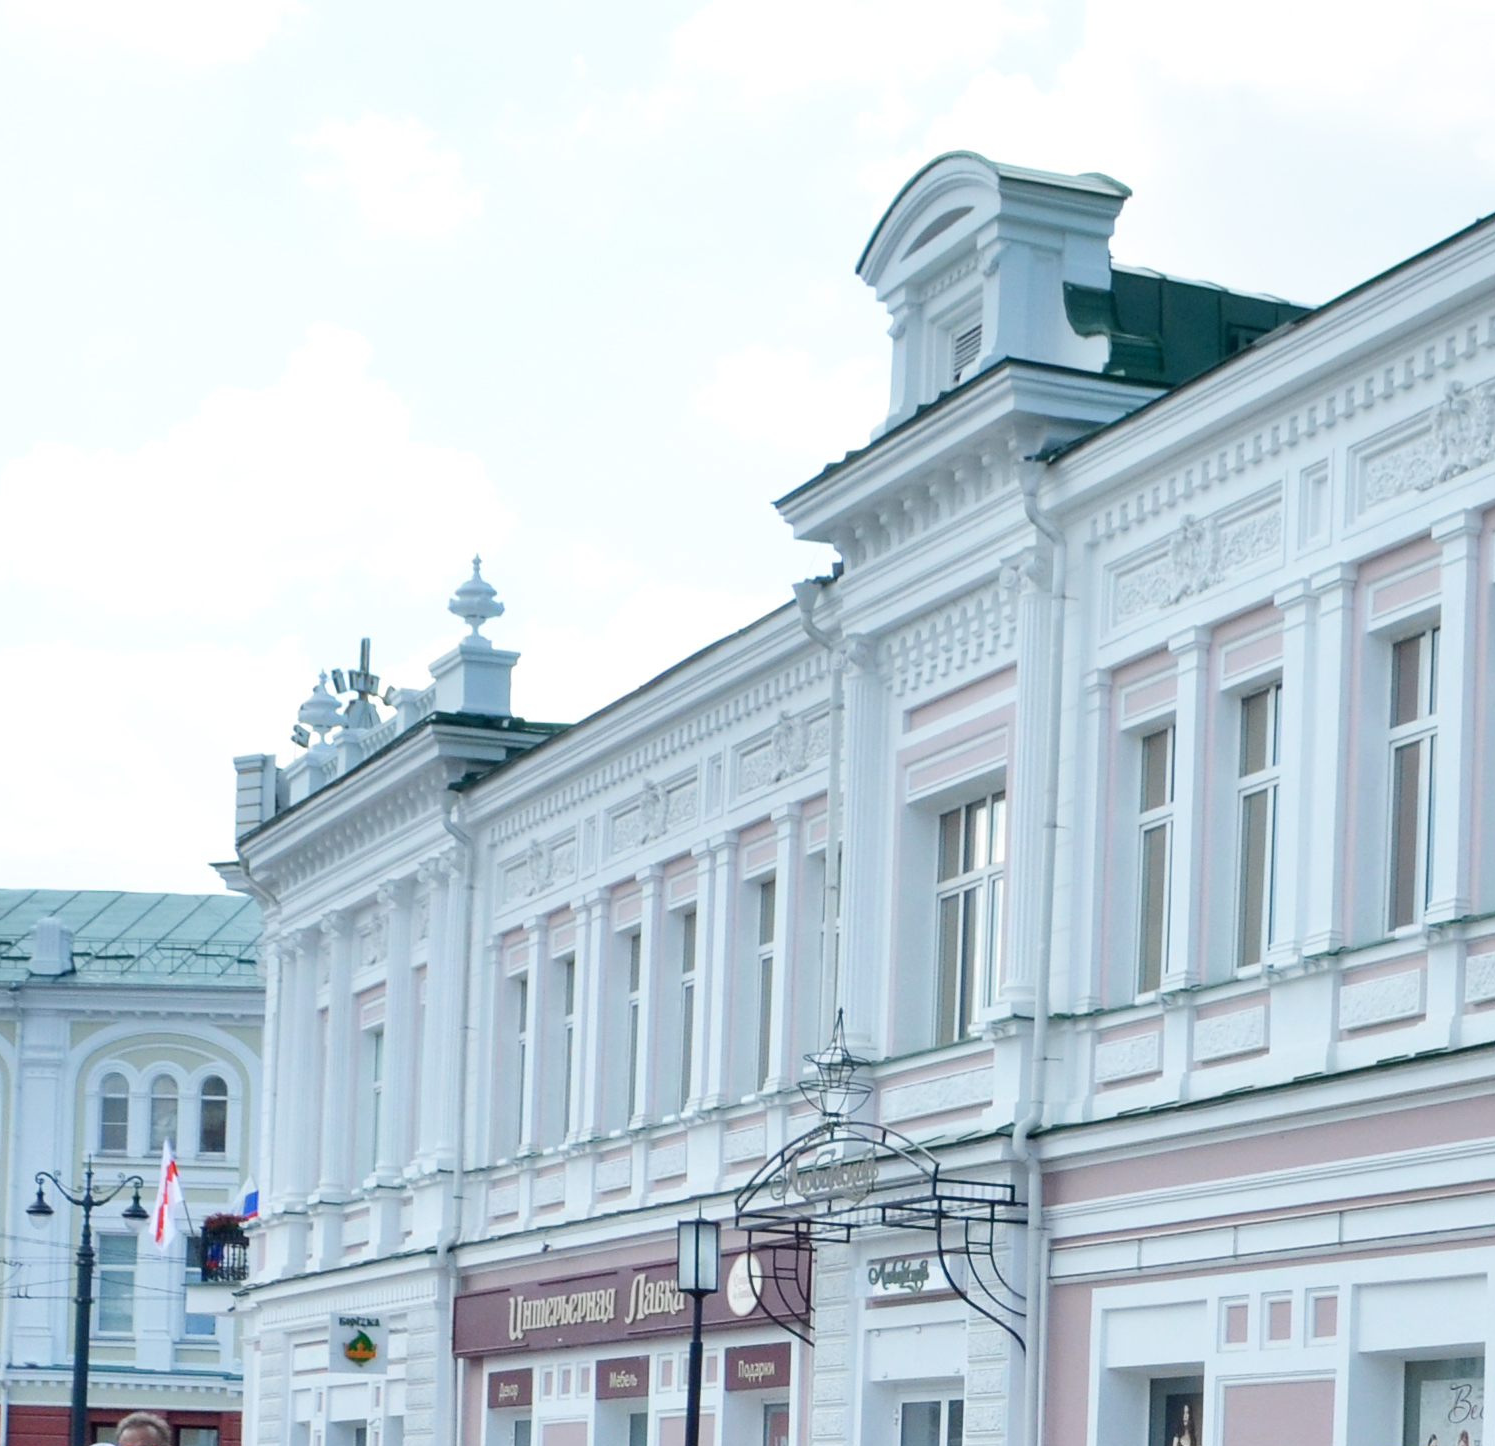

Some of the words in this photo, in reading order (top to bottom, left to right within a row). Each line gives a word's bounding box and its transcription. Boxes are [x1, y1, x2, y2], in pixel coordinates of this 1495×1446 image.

[507, 1287, 617, 1341] Интерьерная
[624, 1273, 685, 1325] Лавка
[609, 1370, 637, 1390] Мебель
[737, 1360, 775, 1383] Подарки
[498, 1382, 519, 1402] Декор
